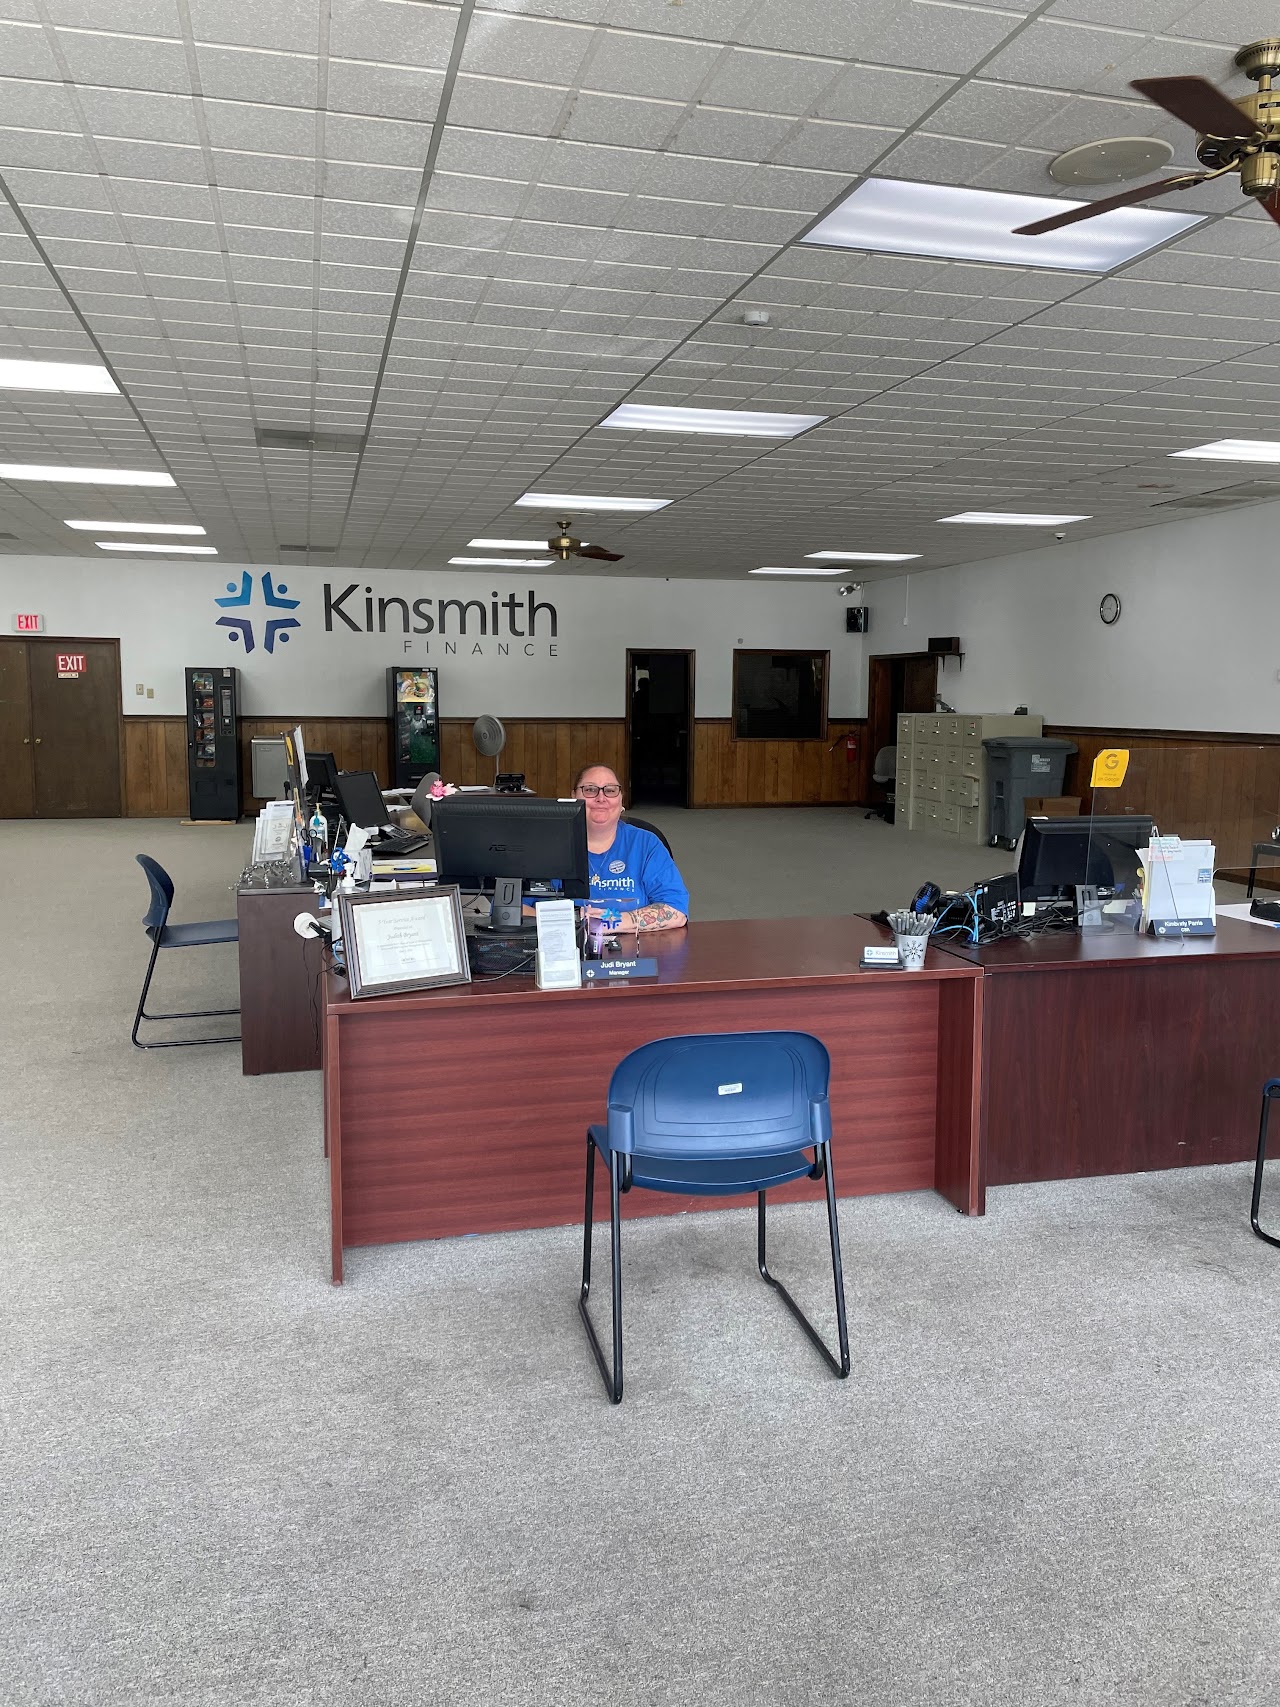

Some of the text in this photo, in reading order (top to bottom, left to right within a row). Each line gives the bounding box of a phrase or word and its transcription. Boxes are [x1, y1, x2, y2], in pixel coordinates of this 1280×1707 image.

[323, 583, 558, 637] Kinsmith
[17, 614, 39, 630] EXIT
[403, 640, 558, 657] FINANCE
[58, 655, 84, 671] EXIT
[1104, 753, 1119, 770] G
[600, 960, 637, 969] Judi Bryant
